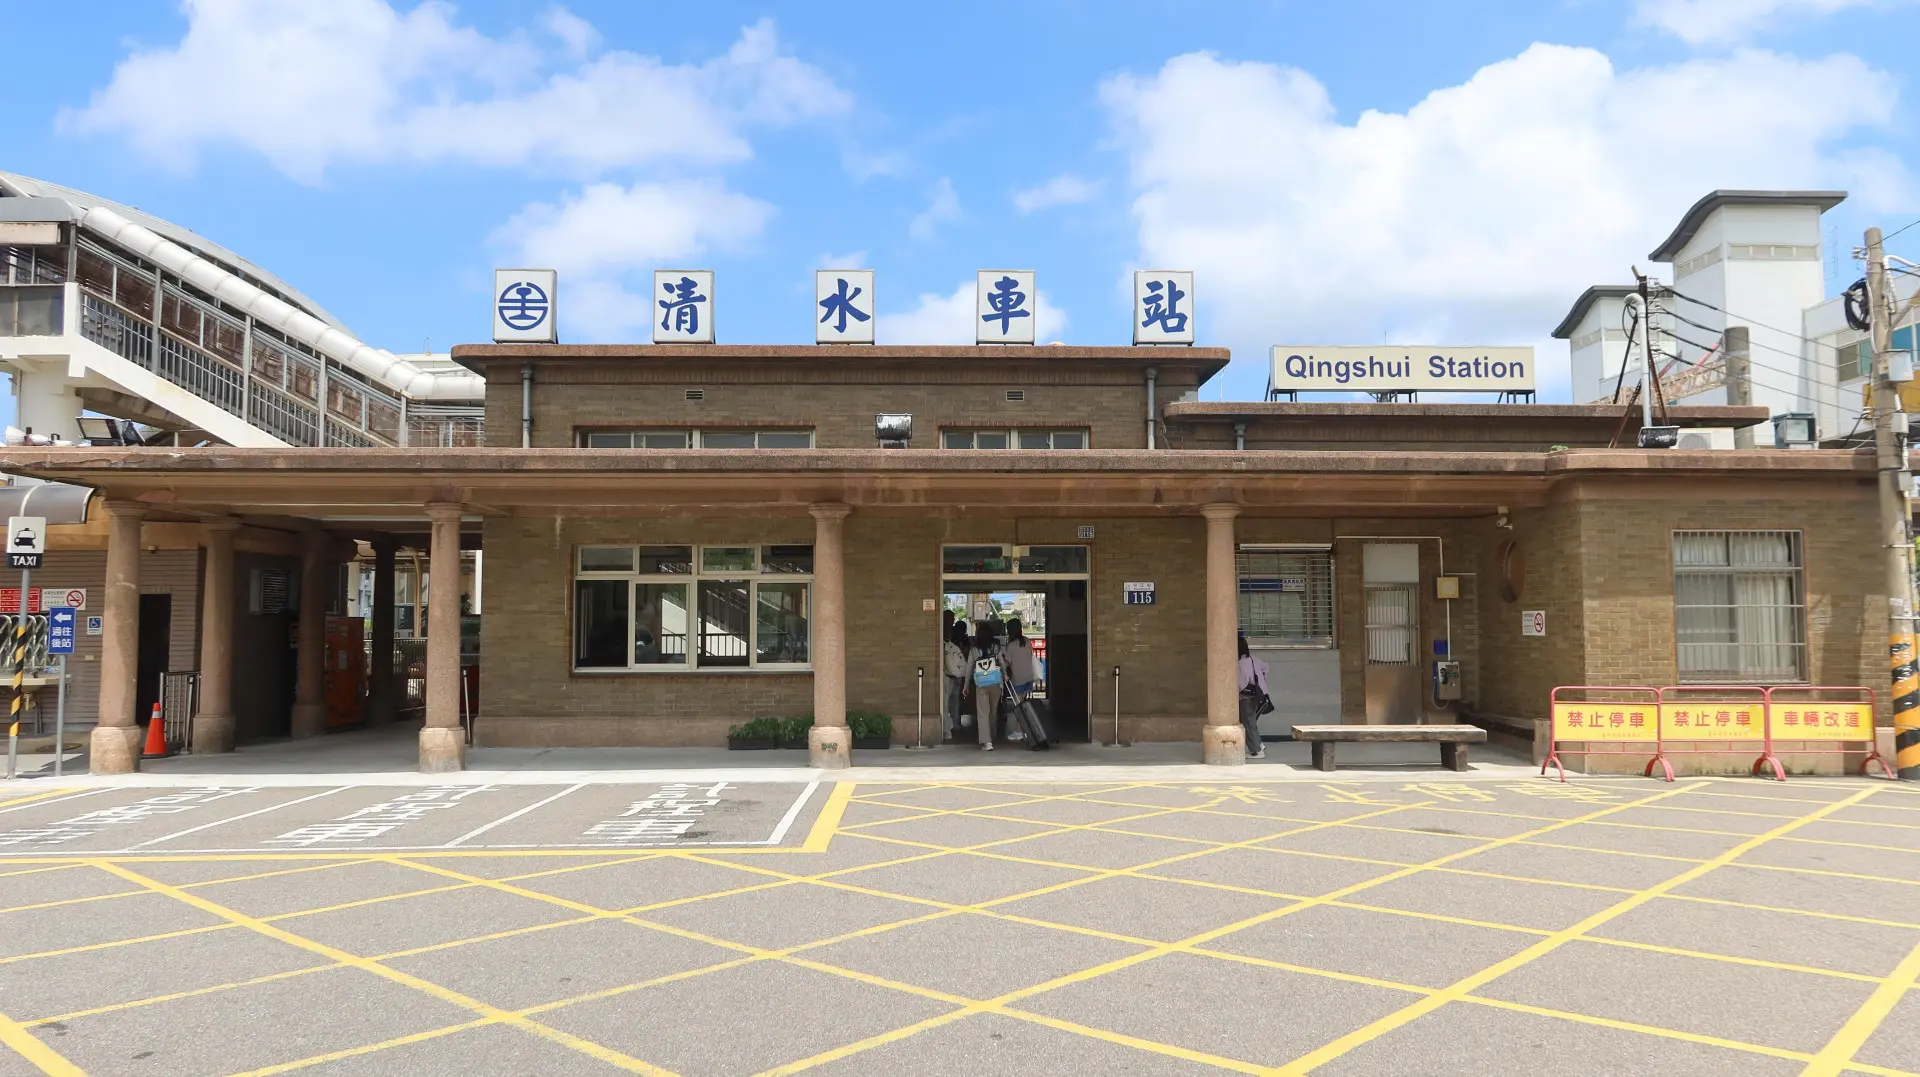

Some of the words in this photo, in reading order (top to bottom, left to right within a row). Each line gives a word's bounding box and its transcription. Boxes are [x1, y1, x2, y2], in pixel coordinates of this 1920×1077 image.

[658, 276, 1188, 335] 清水車站
[1285, 355, 1410, 383] Qingshui
[1428, 355, 1525, 378] Station
[13, 556, 37, 566] TAXI
[1133, 591, 1152, 604] 115
[51, 626, 73, 637] 通往
[51, 638, 72, 648] 後站
[1567, 711, 1645, 728] 禁止停車
[1674, 711, 1751, 727] 禁止停車
[1784, 711, 1860, 727] 車輛改道
